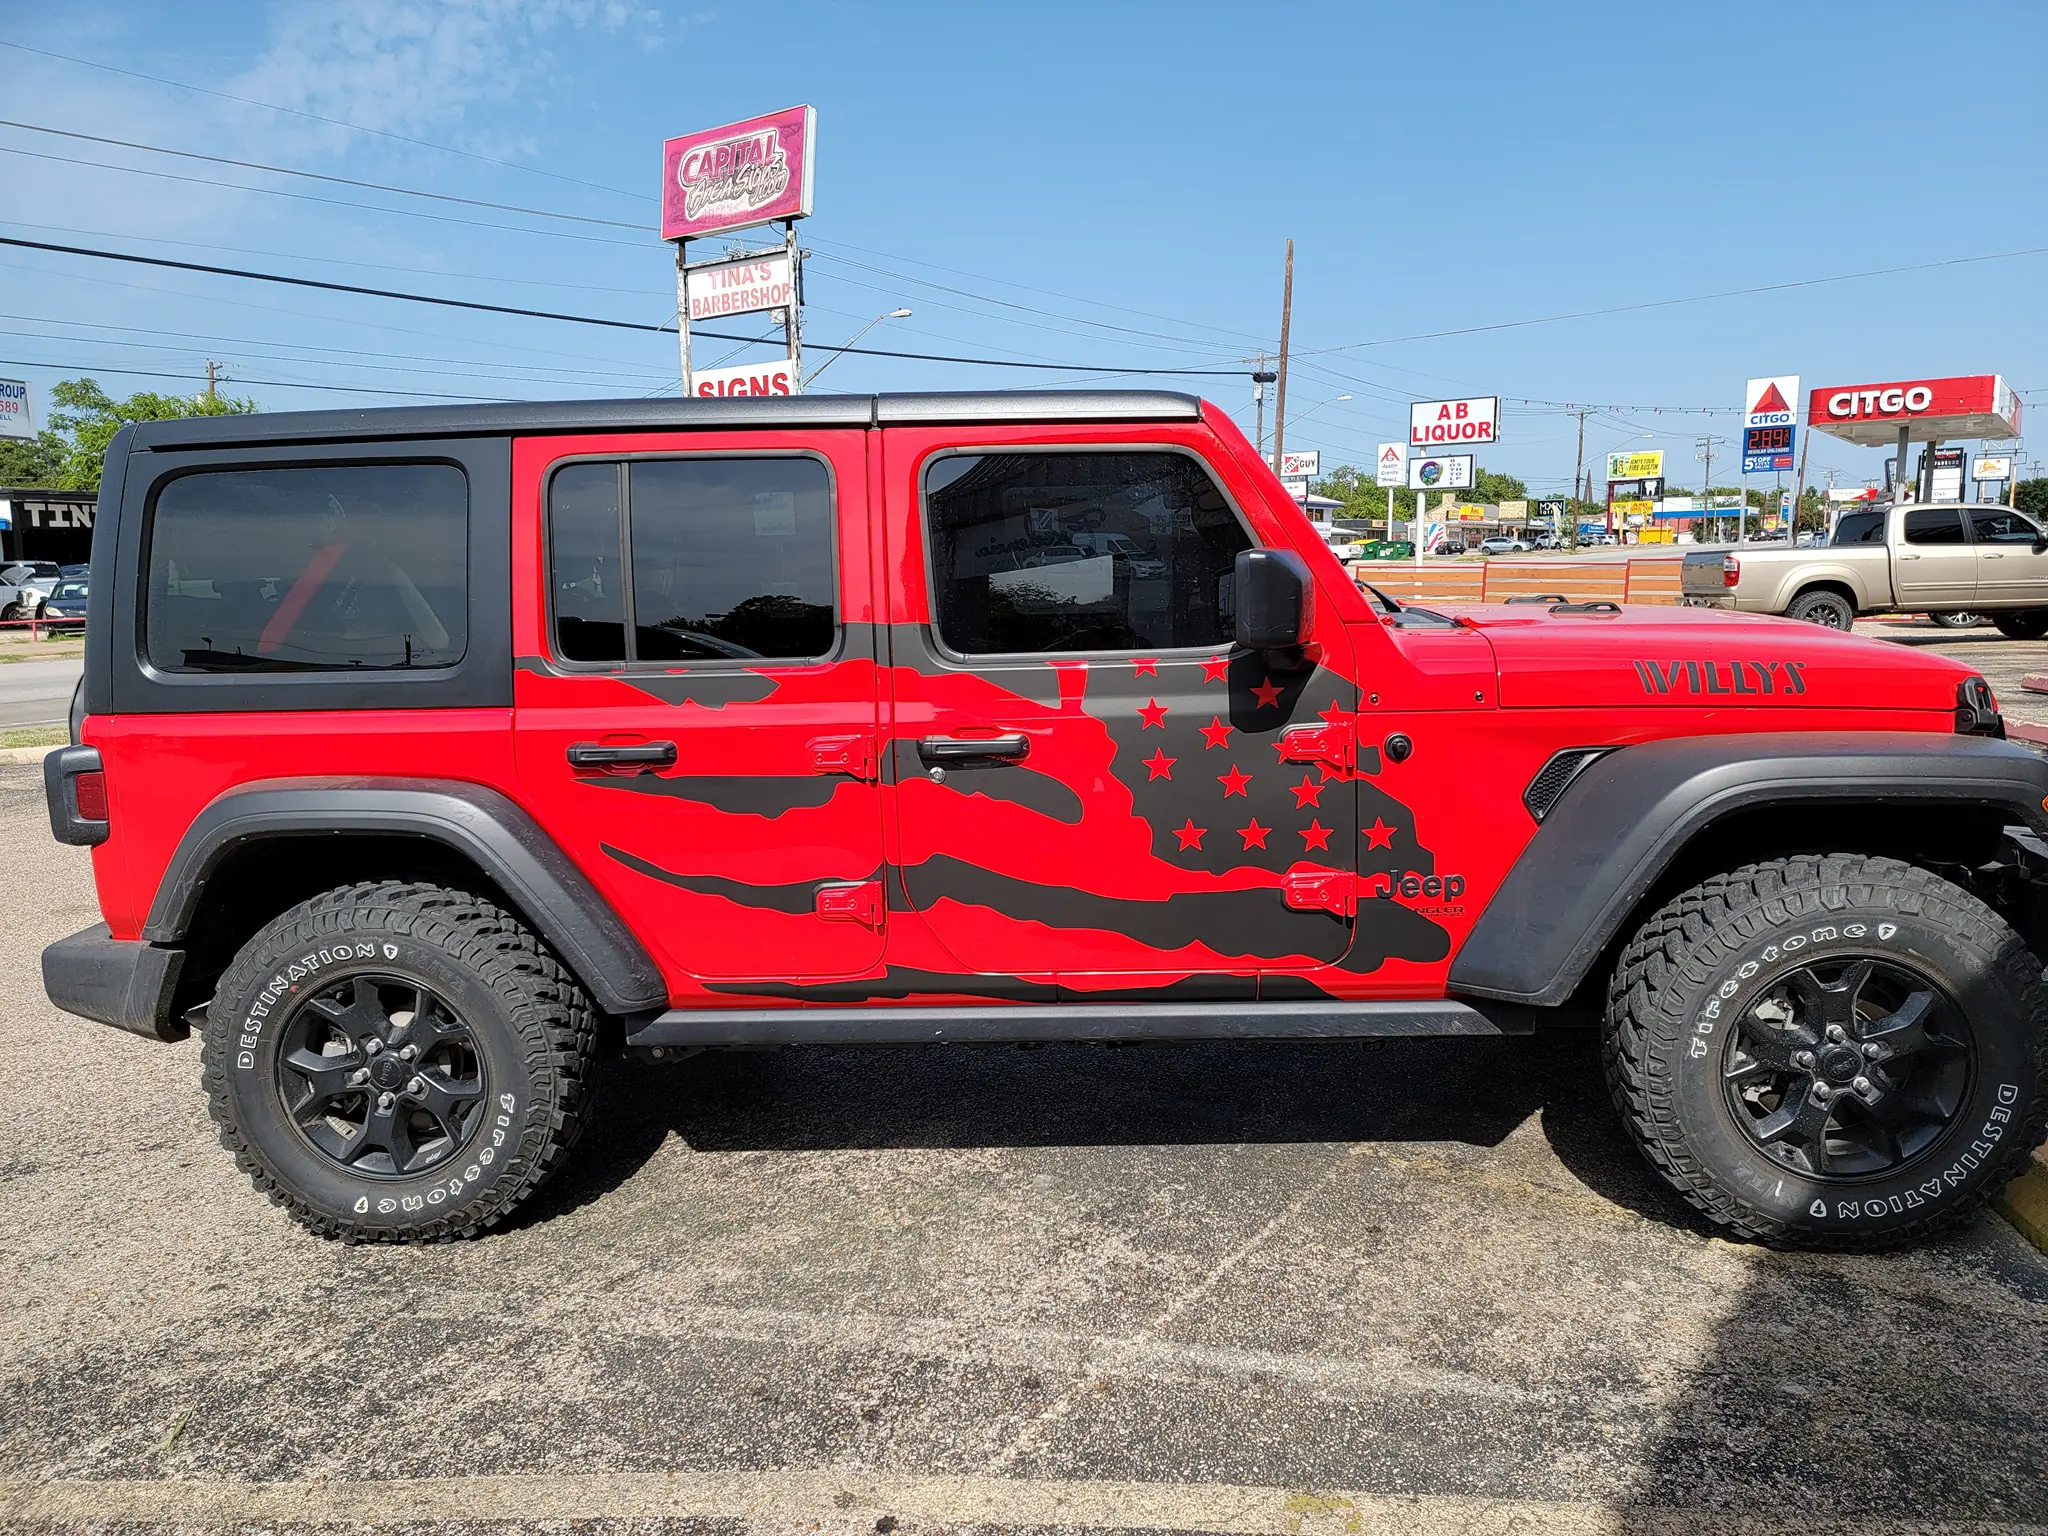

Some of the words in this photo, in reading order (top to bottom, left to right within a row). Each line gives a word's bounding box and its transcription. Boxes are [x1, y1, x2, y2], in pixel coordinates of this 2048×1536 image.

[682, 135, 774, 184] CAPITAL
[708, 262, 772, 291] TINA'S
[692, 282, 790, 318] BARBERSHOP
[698, 372, 790, 398] SIGNS
[1828, 386, 1934, 417] CITGO
[1412, 421, 1492, 442] LIQUOR
[1750, 413, 1790, 425] CITGO
[1299, 459, 1316, 468] GUY
[24, 503, 97, 528] TIN
[1633, 660, 1807, 695] WILLYS
[1375, 869, 1466, 903] Jeep
[237, 943, 376, 1069] DESTINATION
[1837, 1084, 2019, 1219] DESTINATION
